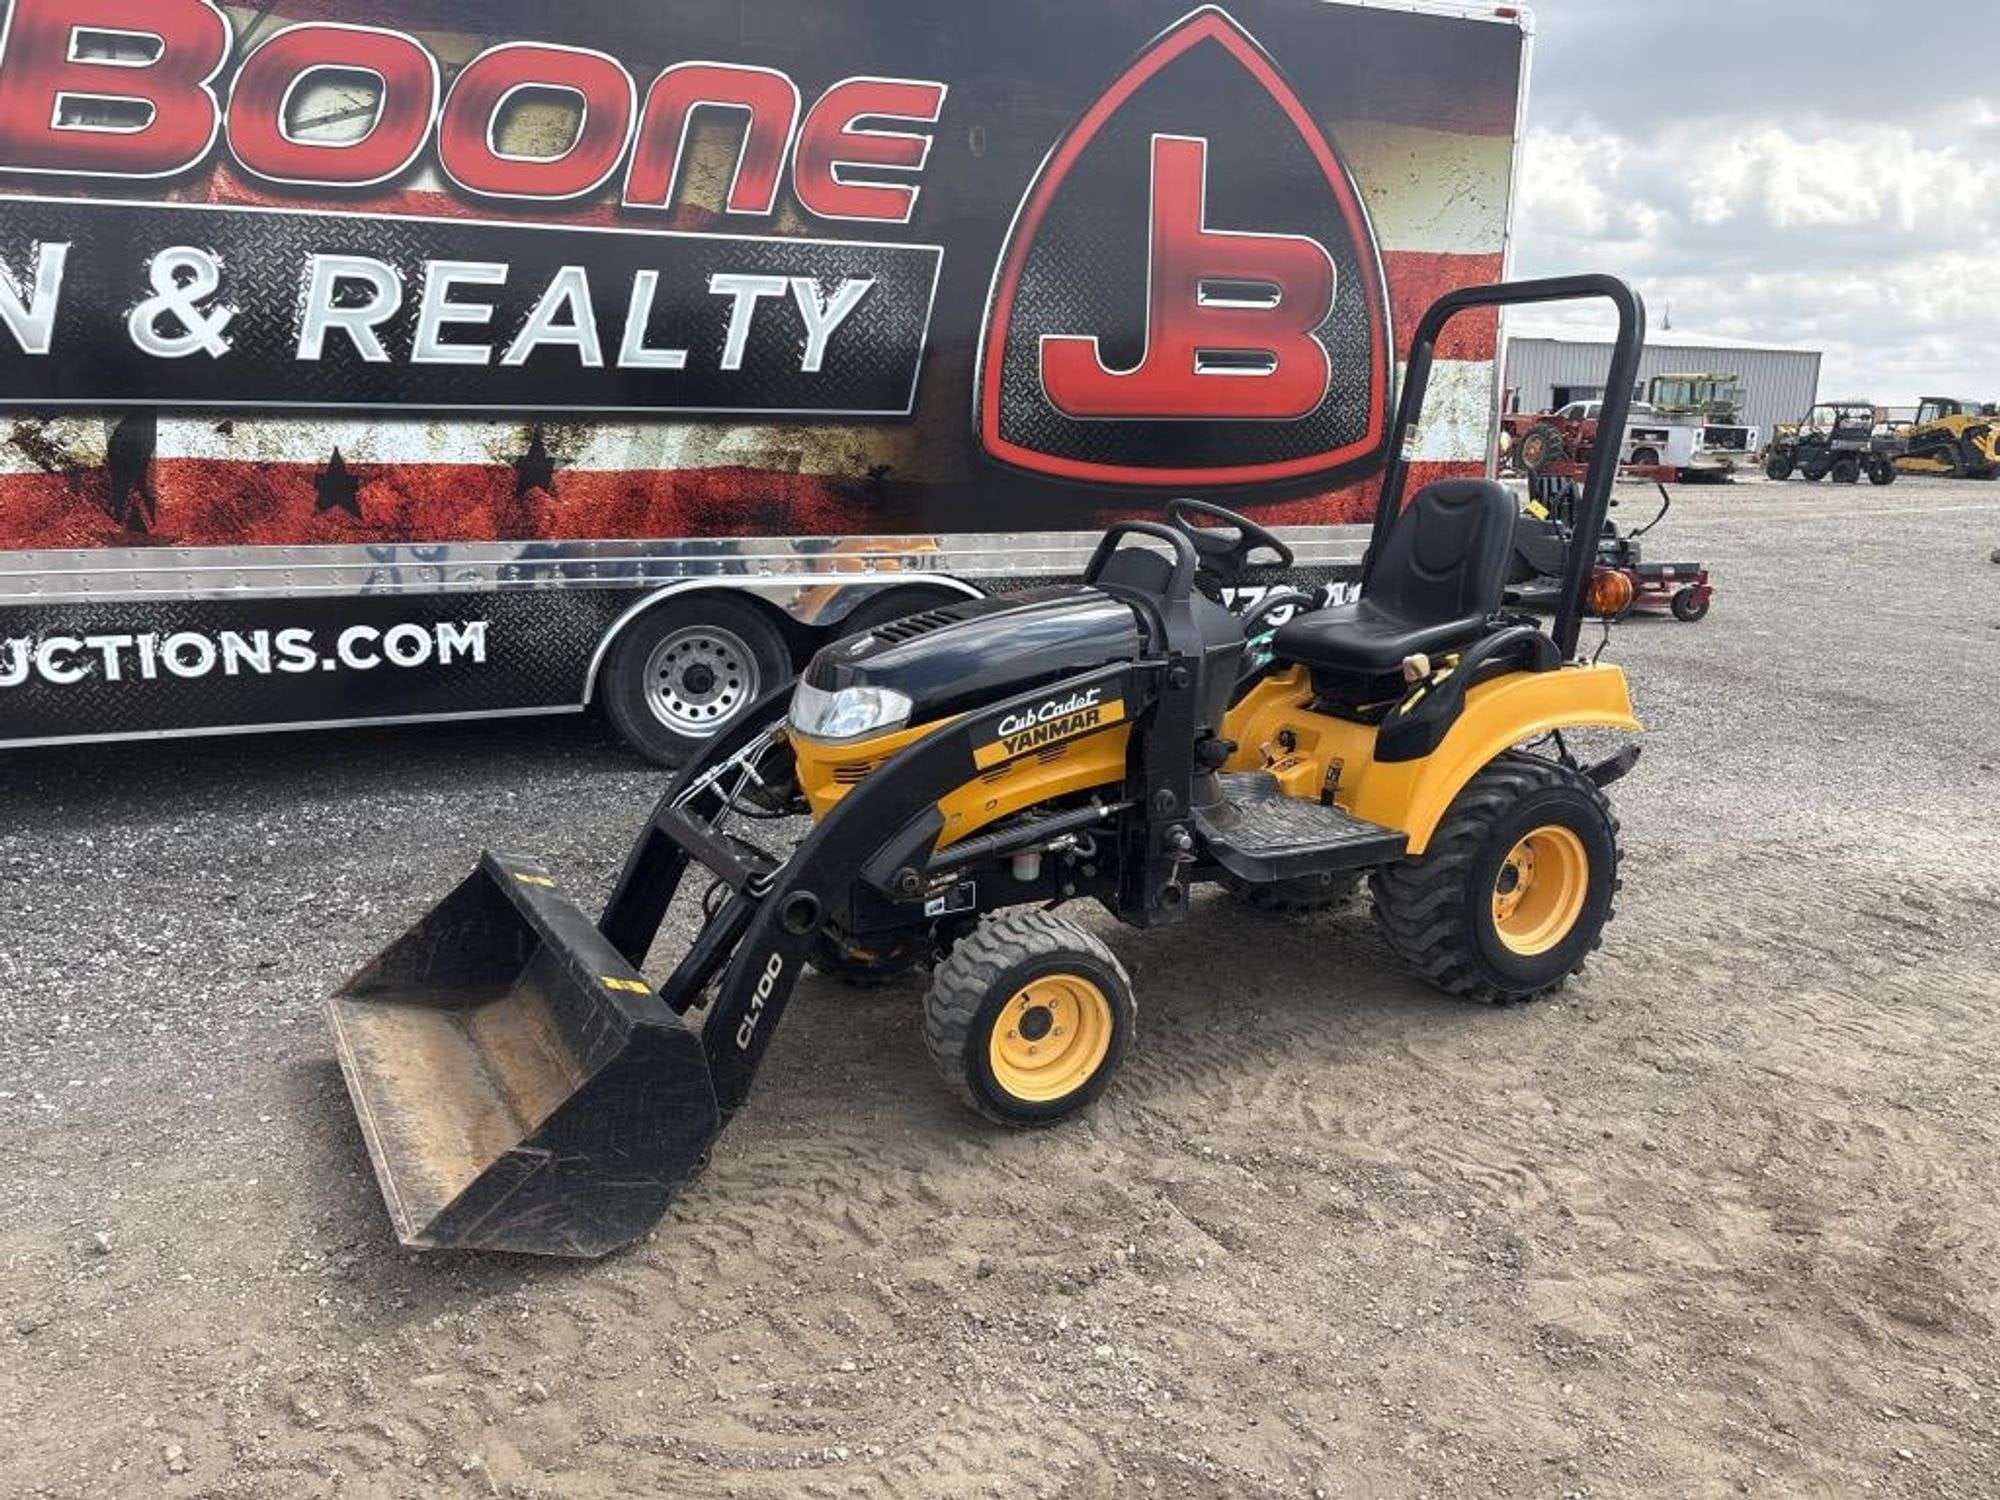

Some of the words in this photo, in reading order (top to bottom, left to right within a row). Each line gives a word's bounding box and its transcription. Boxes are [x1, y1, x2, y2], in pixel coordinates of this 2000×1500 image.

[127, 245, 234, 358] &
[295, 252, 876, 373] REALTY
[1039, 133, 1337, 421] JB
[998, 708, 1036, 737] Cub
[1037, 687, 1101, 722] Cadet
[1002, 708, 1100, 755] YANMAR
[735, 952, 783, 1050] CL100
